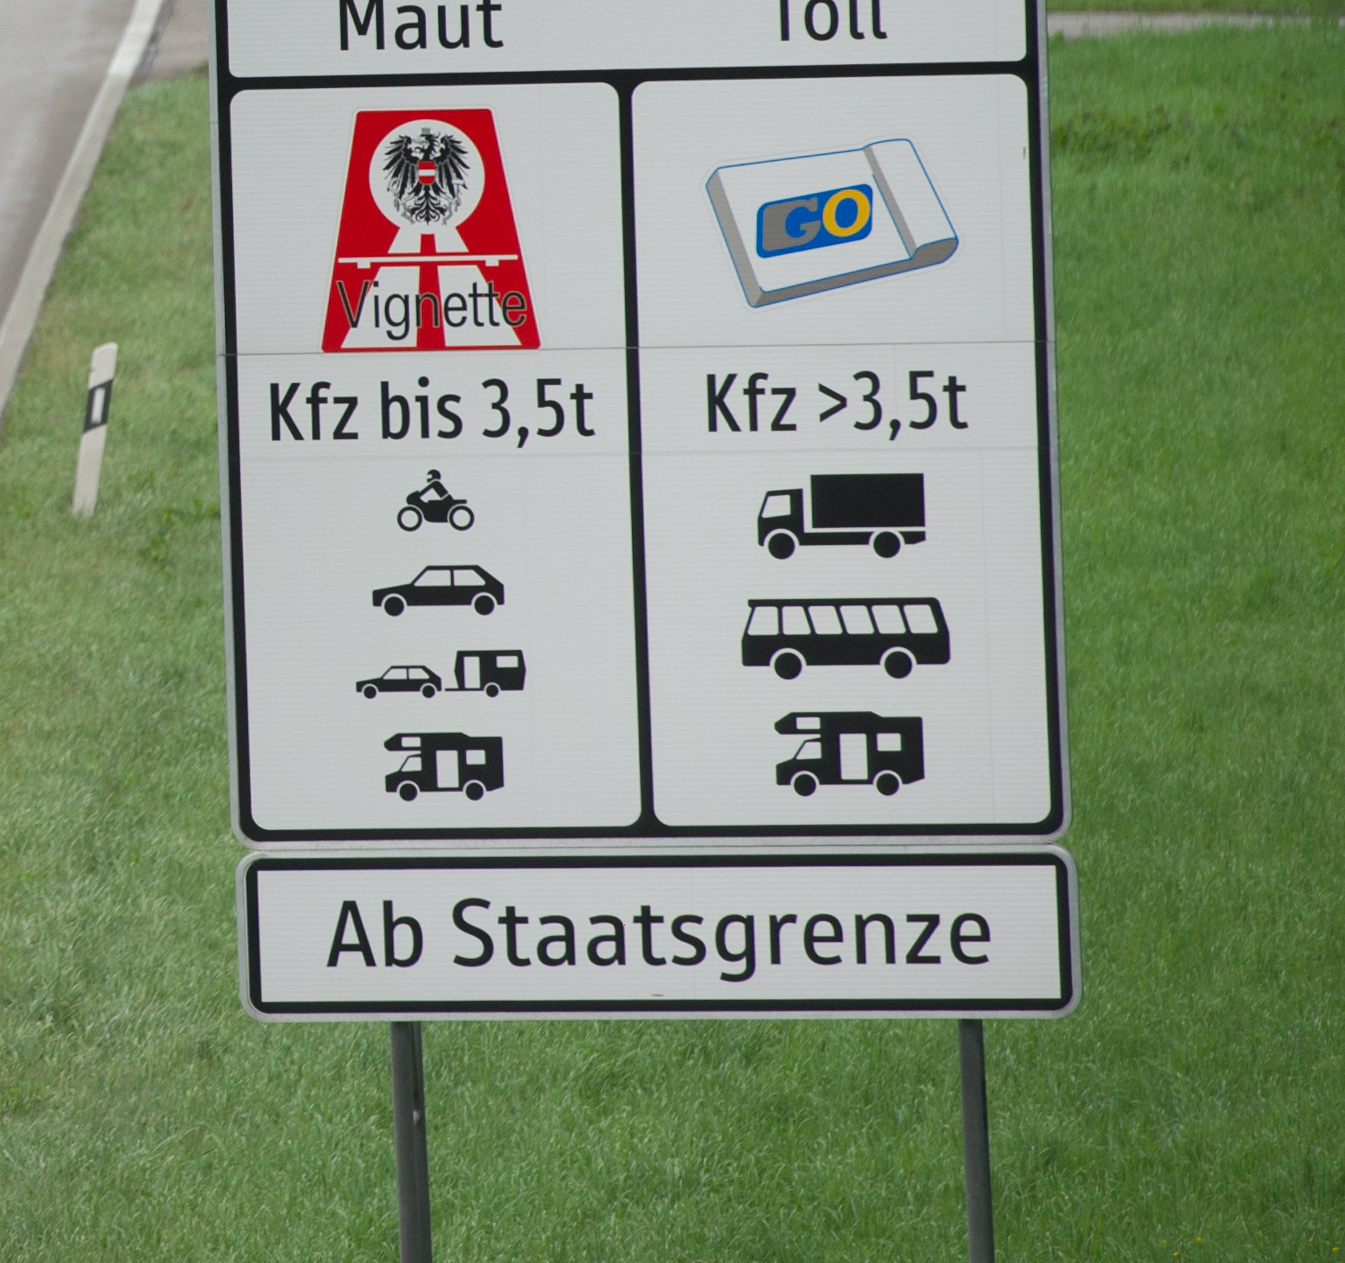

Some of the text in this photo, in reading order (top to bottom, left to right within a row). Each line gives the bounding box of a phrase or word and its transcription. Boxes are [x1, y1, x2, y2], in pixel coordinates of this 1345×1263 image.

[763, 189, 870, 251] GO
[336, 280, 527, 341] Vignette
[271, 377, 594, 448] Kfz bis 3,5t
[708, 373, 796, 432] Kfz
[327, 898, 990, 983] Ab Staatsgrenze
